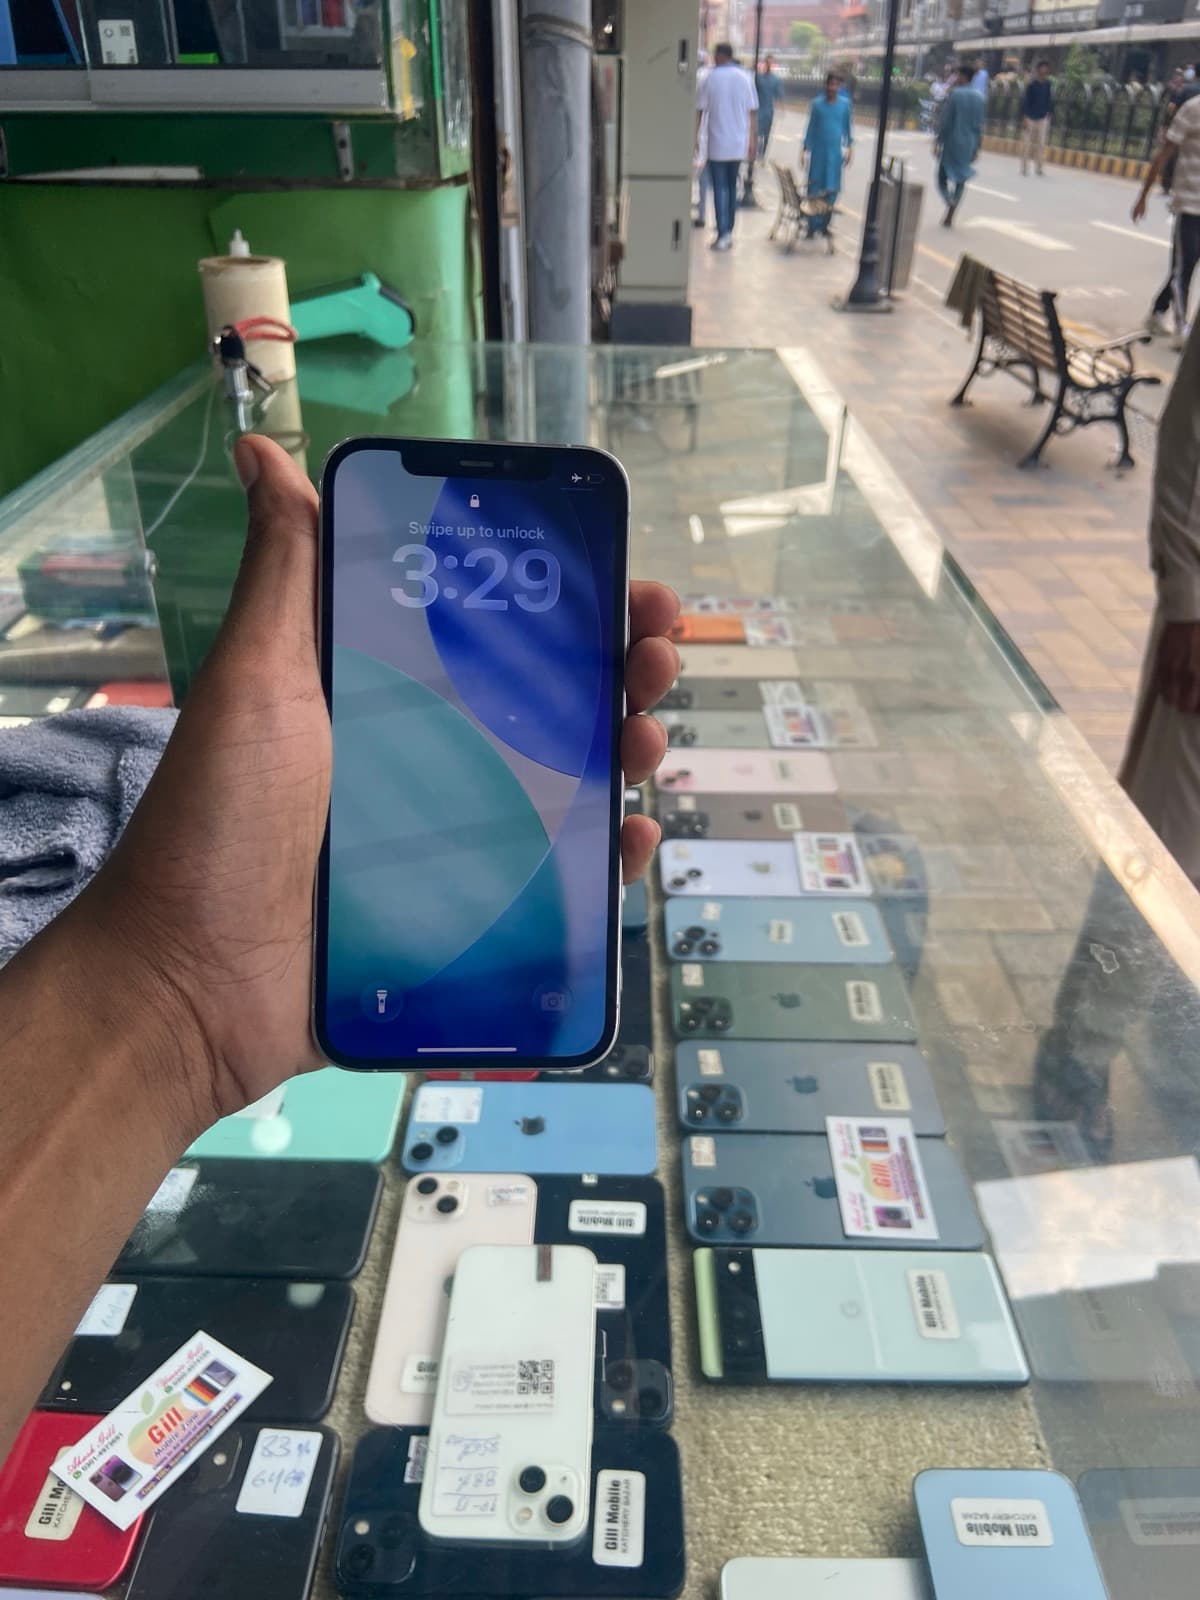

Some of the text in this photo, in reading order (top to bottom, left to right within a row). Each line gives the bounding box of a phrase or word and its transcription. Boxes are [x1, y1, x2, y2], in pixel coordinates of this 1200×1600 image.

[408, 521, 545, 540] Swipe up to unlock
[390, 543, 562, 613] 3:29
[147, 1406, 184, 1445] Gill
[38, 1503, 58, 1525] Gill
[604, 1479, 621, 1550] Gill Mobile
[966, 1521, 1038, 1537] Gill Mobile
